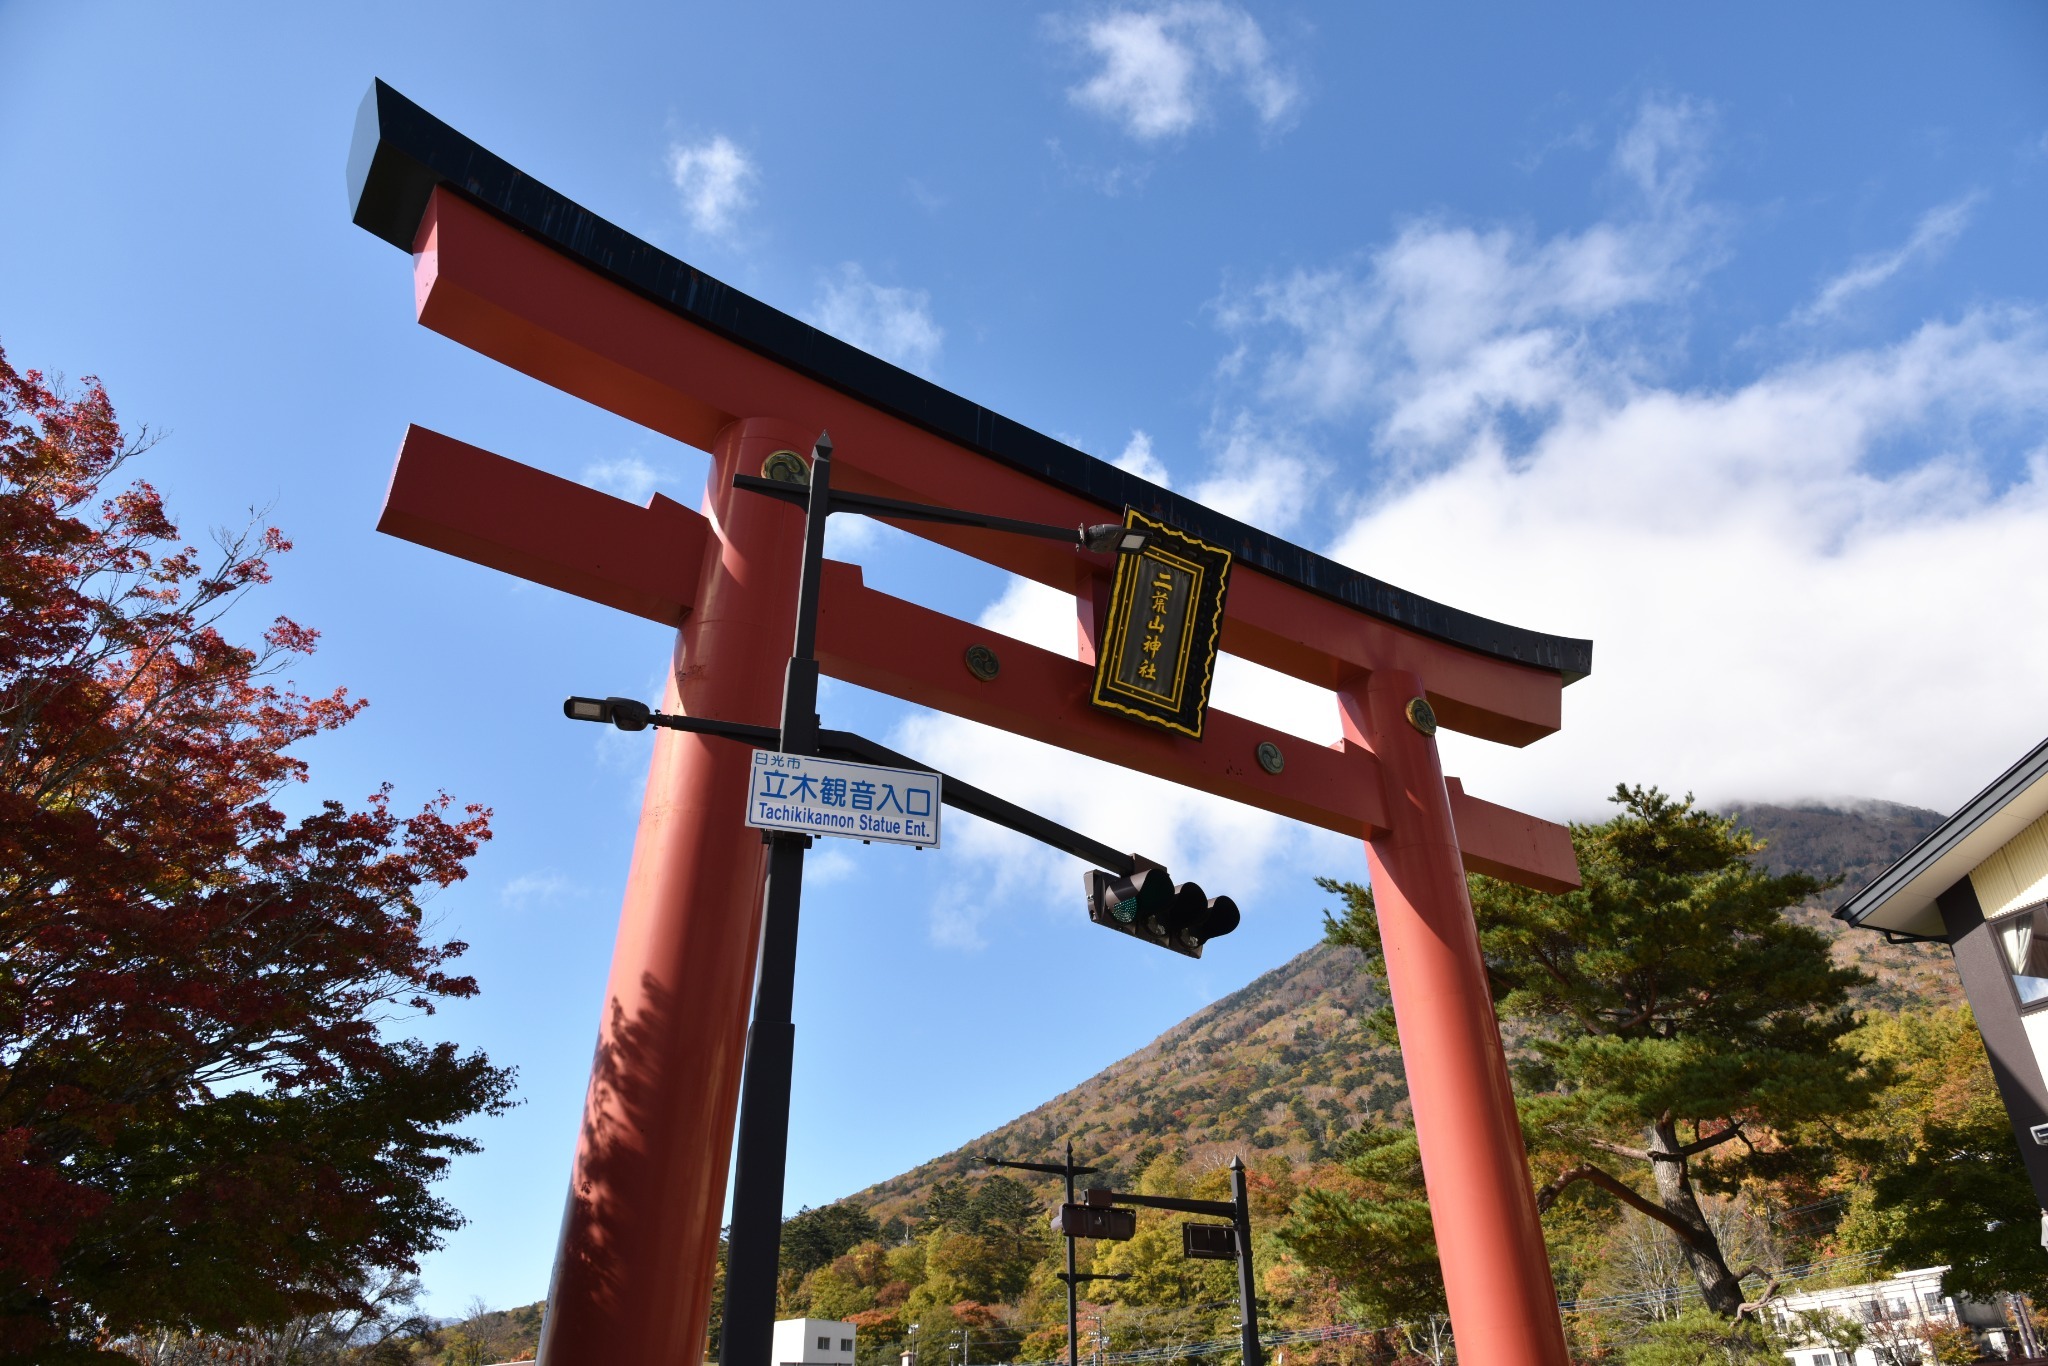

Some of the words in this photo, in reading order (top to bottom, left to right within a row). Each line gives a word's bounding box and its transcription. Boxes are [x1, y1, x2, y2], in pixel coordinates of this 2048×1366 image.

[1138, 572, 1173, 680] 二荒山神社
[755, 752, 801, 770] 日光市
[760, 769, 931, 817] 立木観音入口
[759, 802, 854, 829] Tachikikannon
[859, 814, 901, 834] Statue
[905, 820, 930, 837] Ent.
